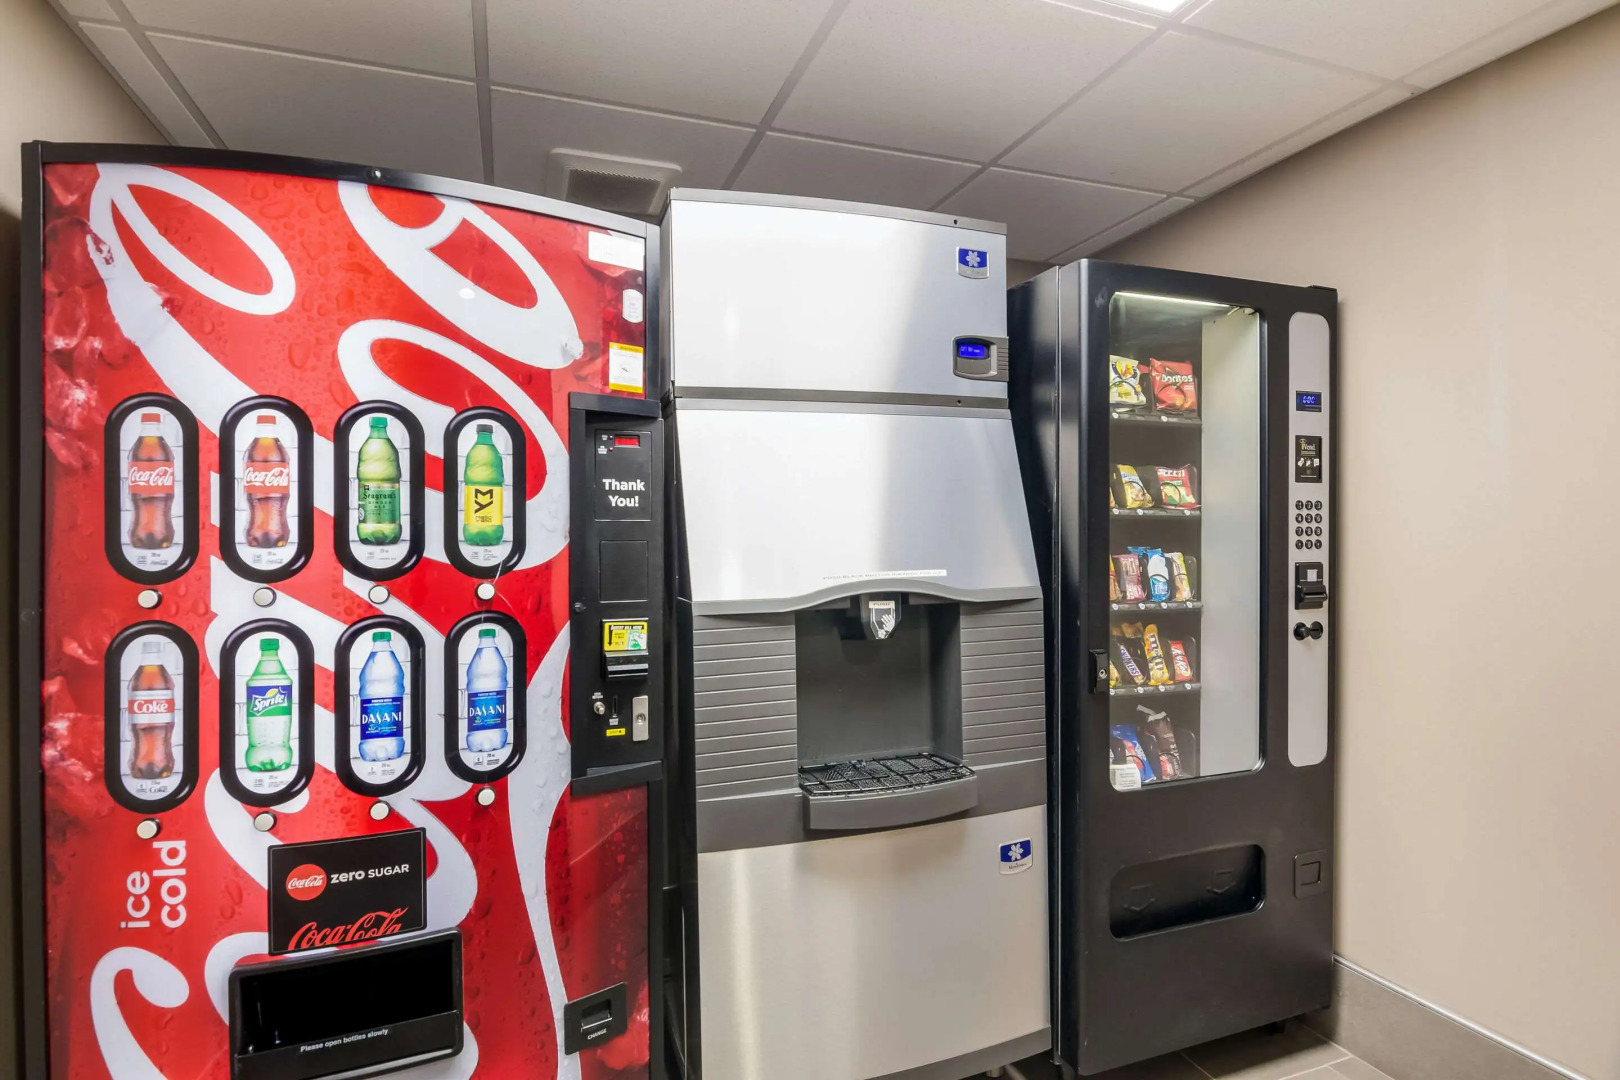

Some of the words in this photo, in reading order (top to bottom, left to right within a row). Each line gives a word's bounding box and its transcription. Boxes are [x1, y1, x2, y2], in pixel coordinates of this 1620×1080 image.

[1161, 374, 1193, 383] Doritos
[129, 466, 173, 486] Coca-Cola
[245, 466, 289, 487] Coca-Cola
[602, 479, 645, 491] Thank
[608, 495, 639, 507] You!
[134, 700, 169, 713] Coke
[253, 692, 285, 712] Sprite
[362, 711, 402, 724] DASANI
[470, 704, 504, 717] DASANI
[153, 840, 186, 928] cold
[288, 875, 325, 889] Coca-Cola
[330, 870, 365, 884] zero
[367, 864, 409, 878] SUGAR
[120, 871, 150, 928] ice
[300, 1043, 323, 1052] Please
[325, 1039, 341, 1047] open
[343, 1034, 366, 1043] bottles
[367, 1029, 388, 1038] slowly
[587, 1028, 607, 1040] CHANGE
